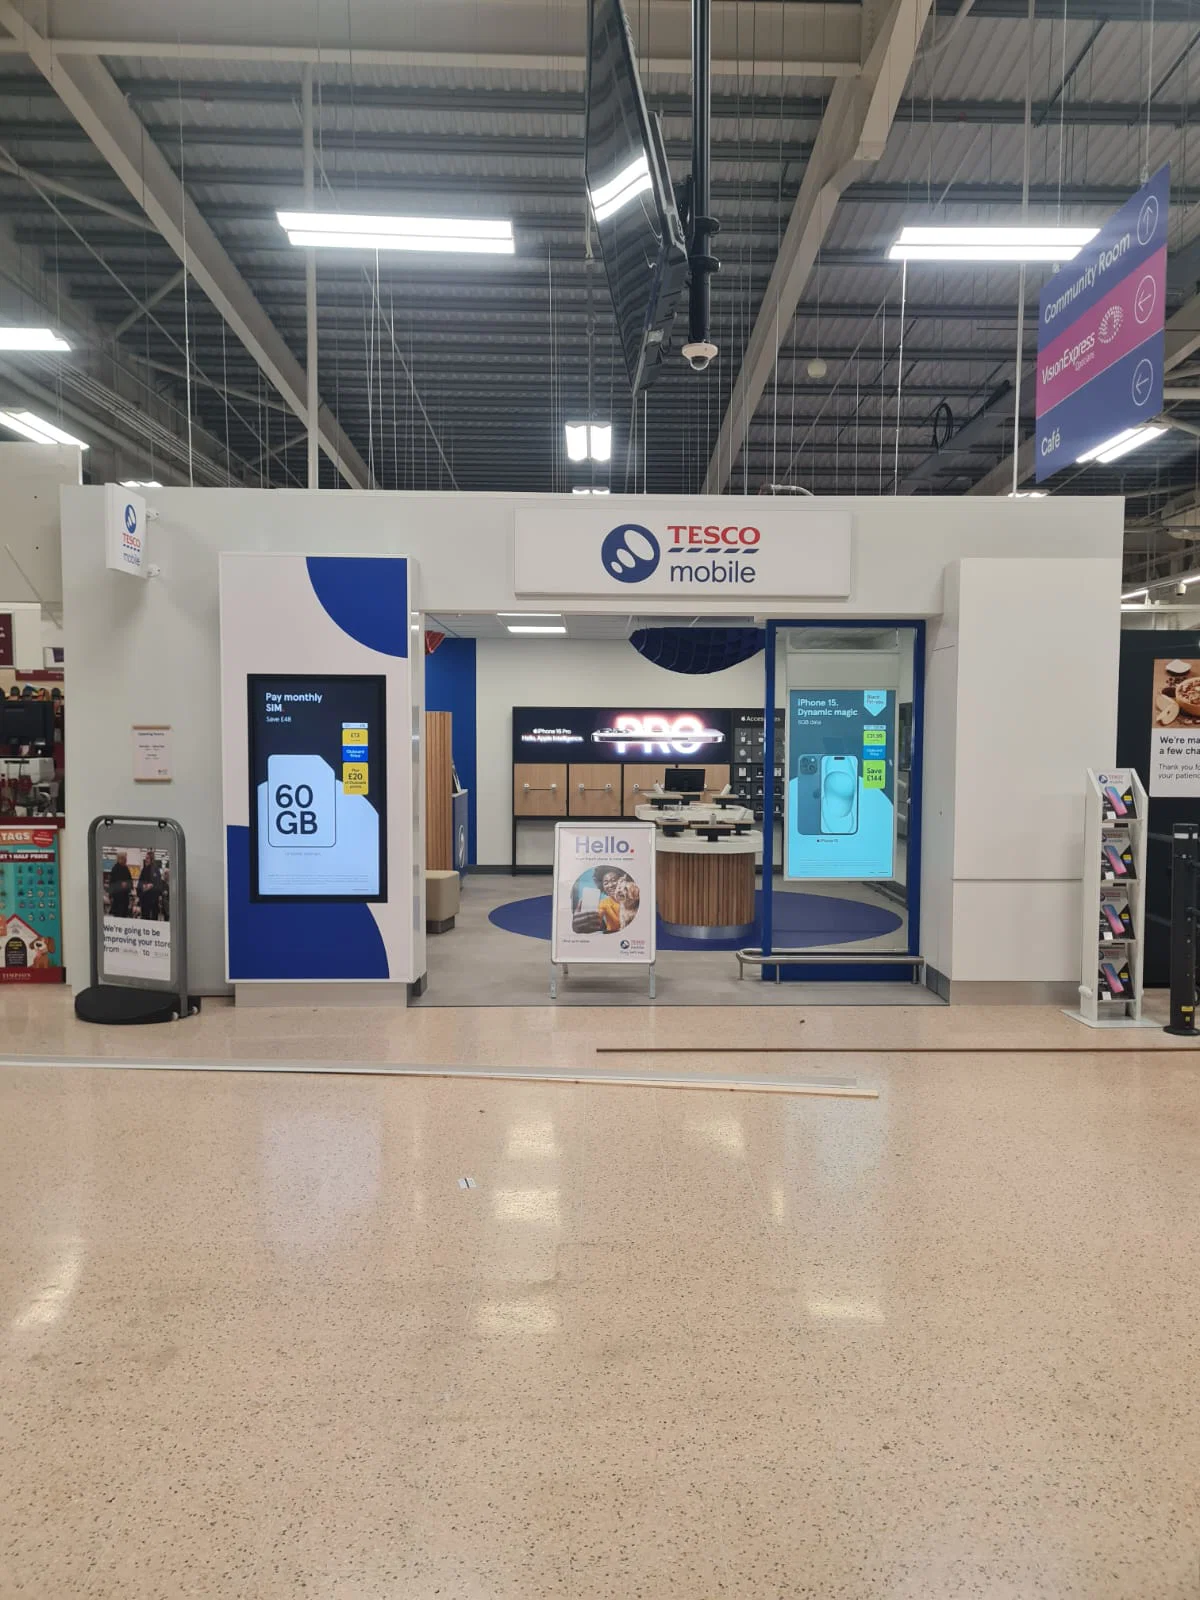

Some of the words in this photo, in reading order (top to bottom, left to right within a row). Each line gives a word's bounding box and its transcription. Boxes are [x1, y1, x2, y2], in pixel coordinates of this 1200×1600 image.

[1044, 262, 1098, 325] Community
[1098, 233, 1131, 276] Room
[1041, 427, 1061, 457] Café
[122, 532, 141, 548] TESCO
[667, 526, 761, 545] TESCO
[670, 560, 756, 583] mobile
[265, 692, 282, 703] Pay
[284, 693, 323, 703] monthly
[797, 698, 826, 706] iPhone
[797, 708, 832, 716] Dynamic
[834, 708, 858, 717] magic
[615, 714, 705, 754] PRO
[1159, 736, 1185, 744] We're
[1167, 747, 1183, 755] few
[275, 784, 314, 808] 60
[275, 811, 318, 835] GB
[575, 836, 635, 854] Hello.
[104, 925, 123, 933] We're
[124, 927, 142, 936] going
[143, 928, 151, 936] to
[151, 928, 161, 936] be
[138, 938, 153, 947] your
[104, 945, 120, 953] from
[143, 949, 151, 957] to
